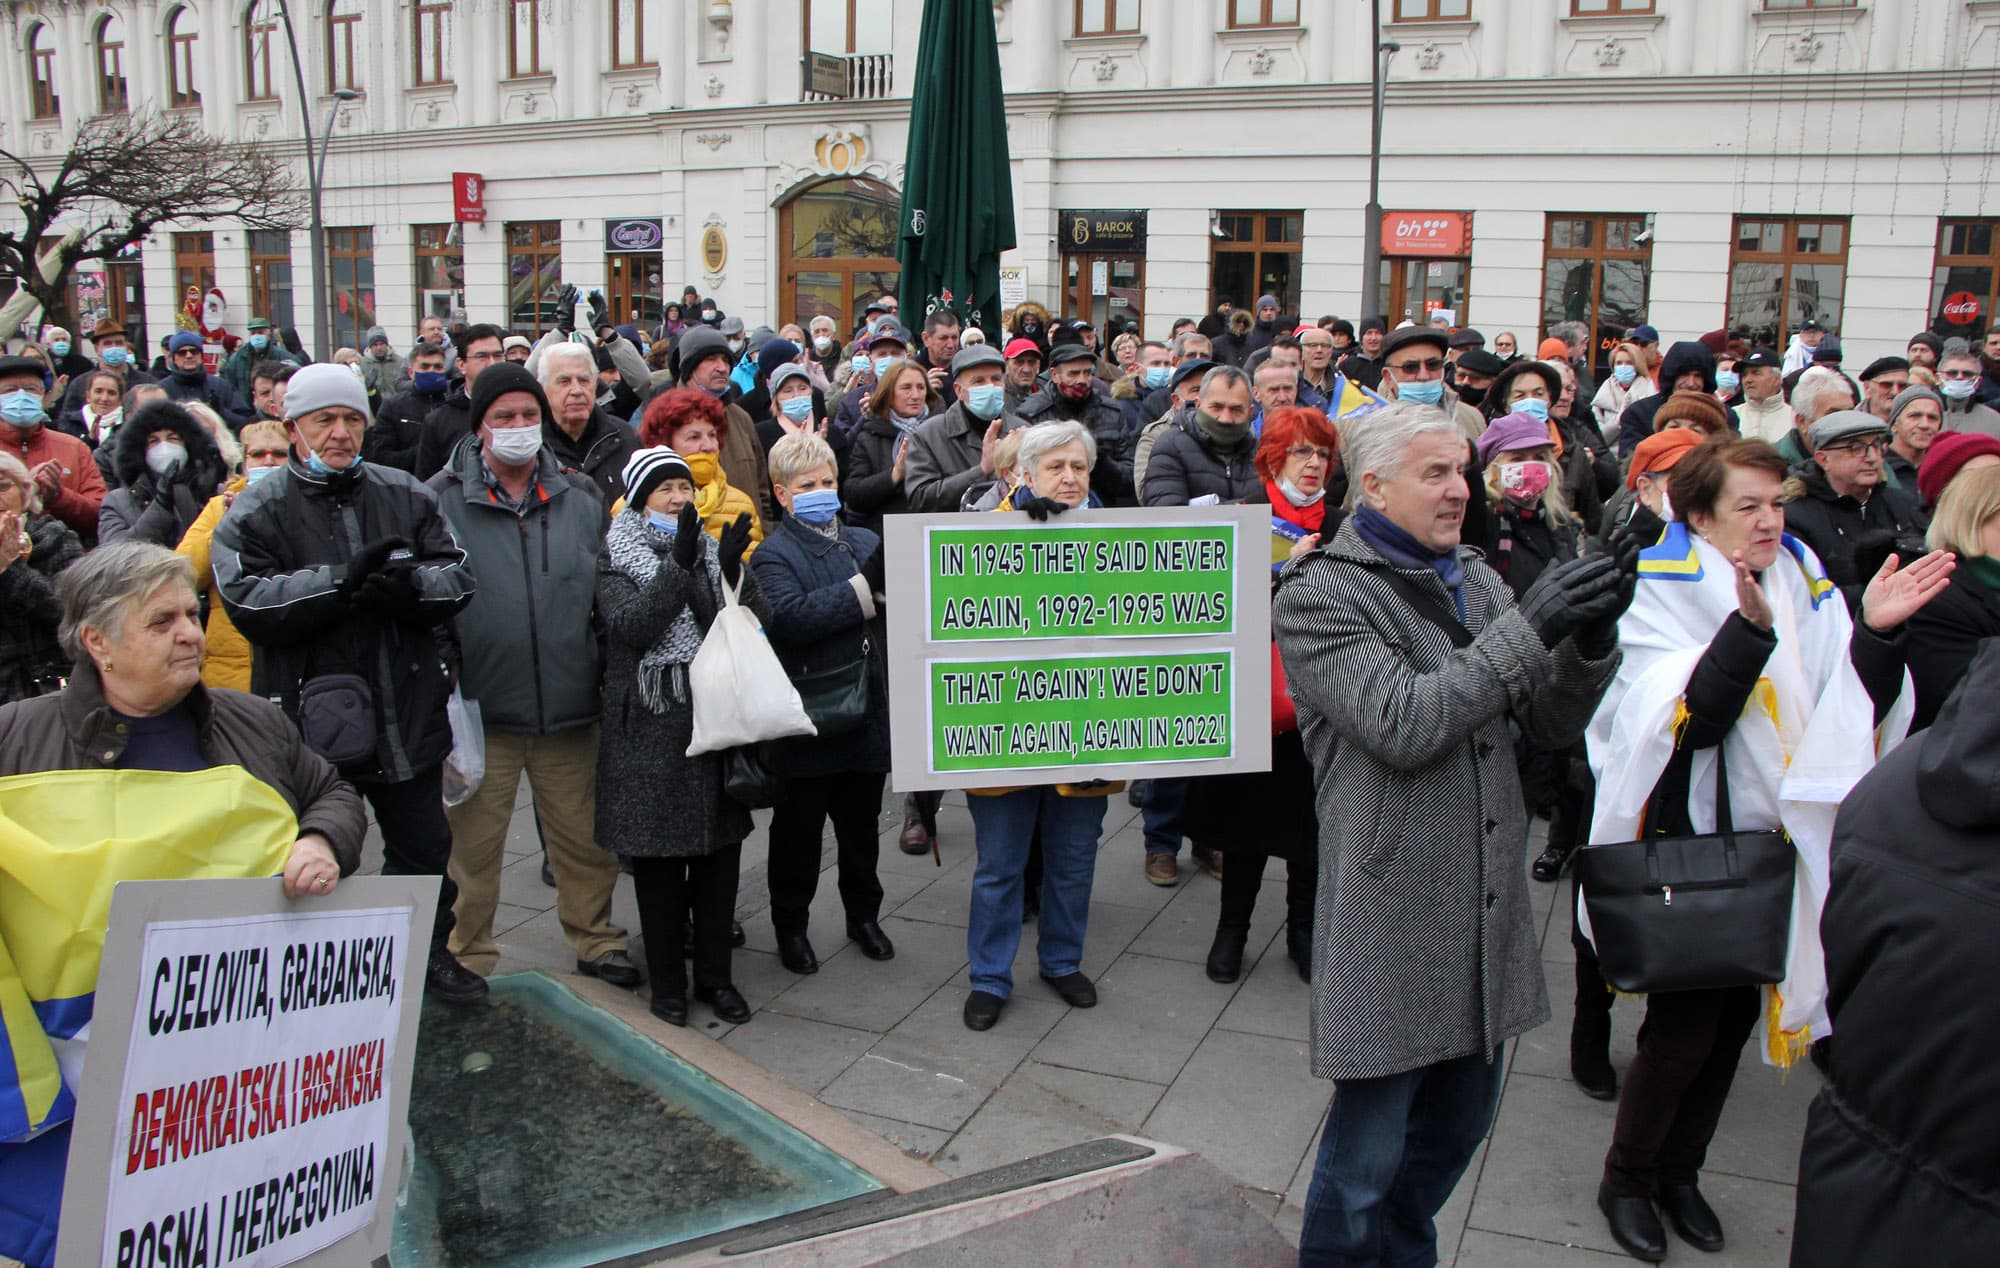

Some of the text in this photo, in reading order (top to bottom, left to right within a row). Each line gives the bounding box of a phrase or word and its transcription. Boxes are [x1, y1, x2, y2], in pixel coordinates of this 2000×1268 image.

[1096, 221, 1133, 232] BAROK
[1396, 220, 1421, 237] bh
[1000, 271, 1020, 280] ROK
[940, 539, 1228, 577] IN 1945 THEY SAID NEVER
[941, 591, 1227, 635] AGAIN, 1992-1995 WAS
[941, 671, 1006, 705] THAT
[1112, 666, 1149, 698] WE
[943, 714, 1227, 761] WANT AGAIN, AGAIN IN 2022!
[148, 935, 397, 1037] CJELOVITA, GRAĐANSKA,
[125, 1038, 386, 1177] DEMOKRATSKA I BOSANSKA
[215, 1194, 229, 1268] I
[228, 1142, 376, 1263] HERCEGOVINA
